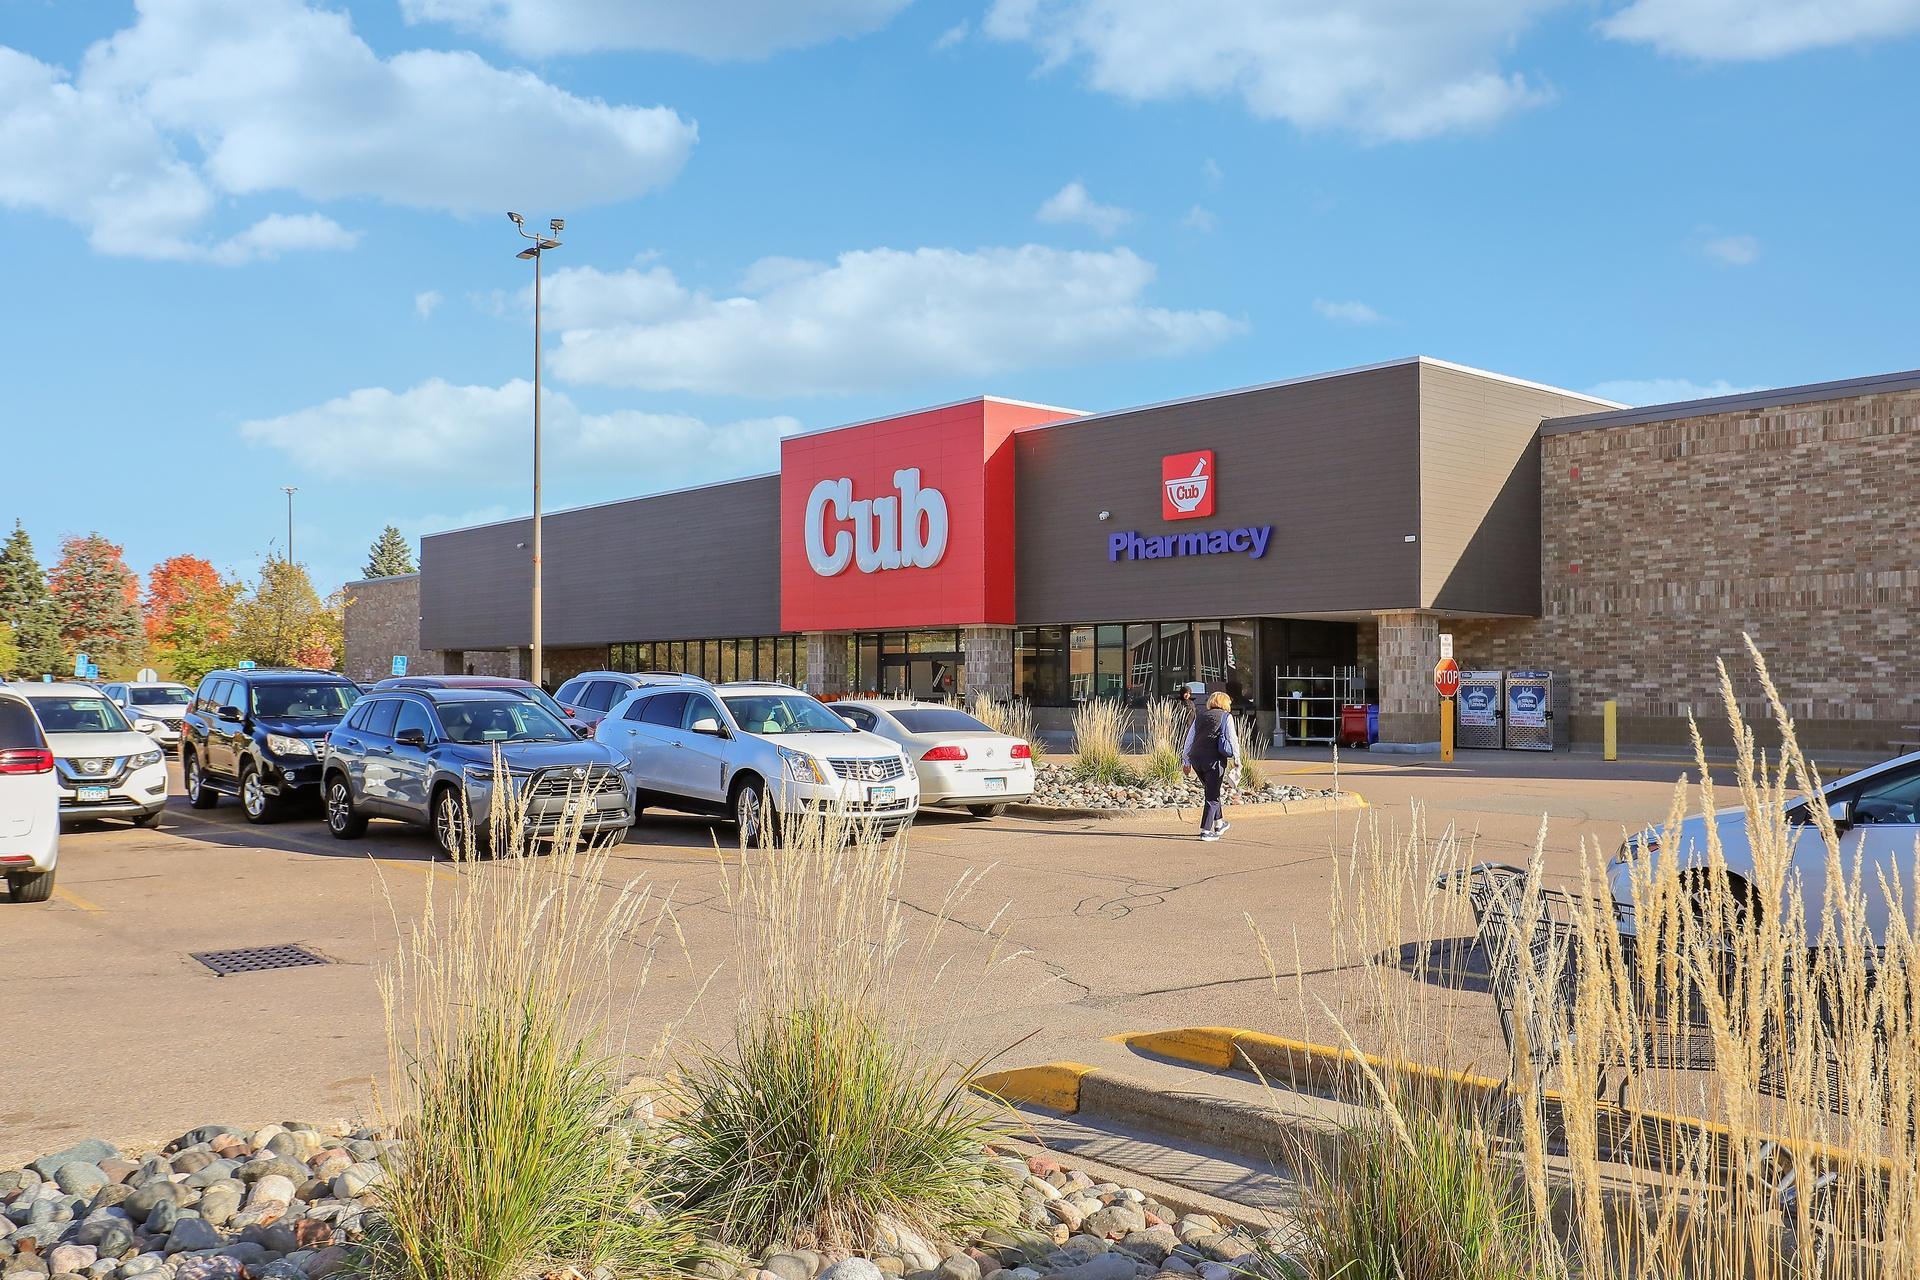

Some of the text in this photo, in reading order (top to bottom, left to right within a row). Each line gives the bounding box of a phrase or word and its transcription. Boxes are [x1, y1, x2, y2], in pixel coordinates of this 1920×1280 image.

[1176, 485, 1199, 500] Cub
[804, 467, 949, 577] Cub
[1108, 526, 1271, 562] Pharmacy
[1437, 670, 1458, 685] STOP
